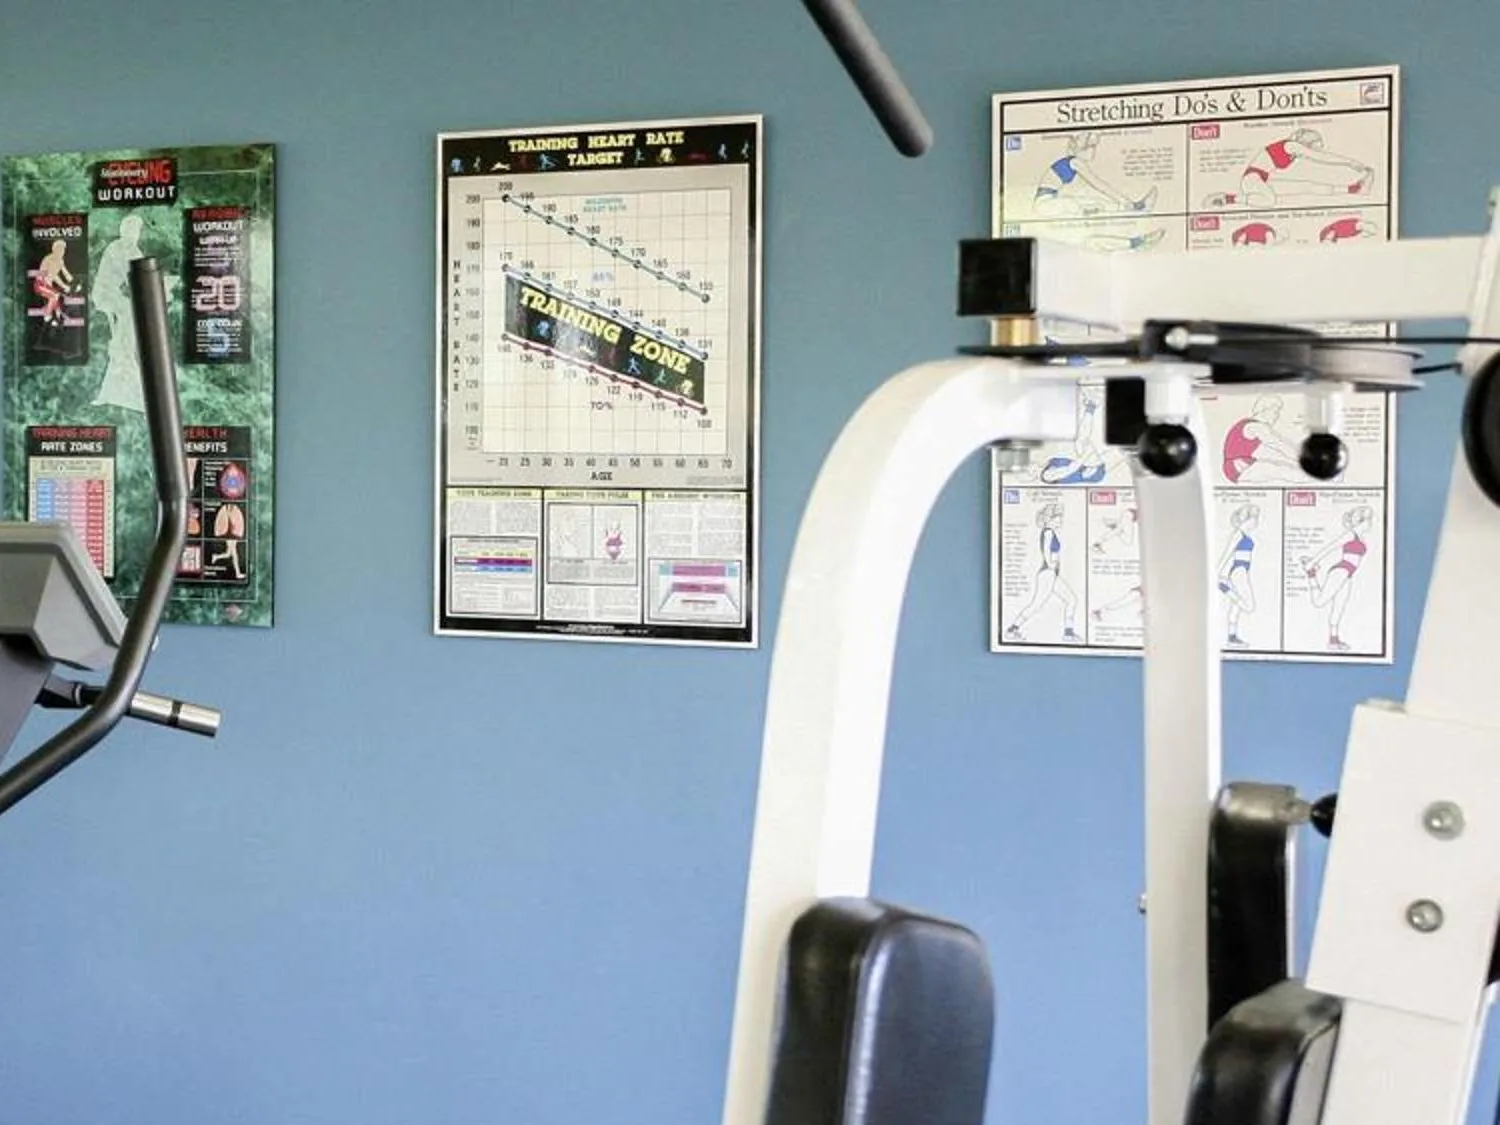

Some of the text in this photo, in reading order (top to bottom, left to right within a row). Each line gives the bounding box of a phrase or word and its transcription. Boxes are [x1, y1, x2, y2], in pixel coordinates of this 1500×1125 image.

[1057, 85, 1329, 124] Stretching Do's & Don'ts
[508, 131, 684, 152] TRAINING HEART RATE
[567, 152, 624, 166] TARGET
[98, 186, 175, 200] WORKOUT
[32, 226, 82, 237] INVOLVED
[194, 275, 242, 311] 20
[521, 286, 691, 375] TRAINING ZONE
[41, 441, 103, 453] RATE ZONES
[590, 472, 613, 481] AGE
